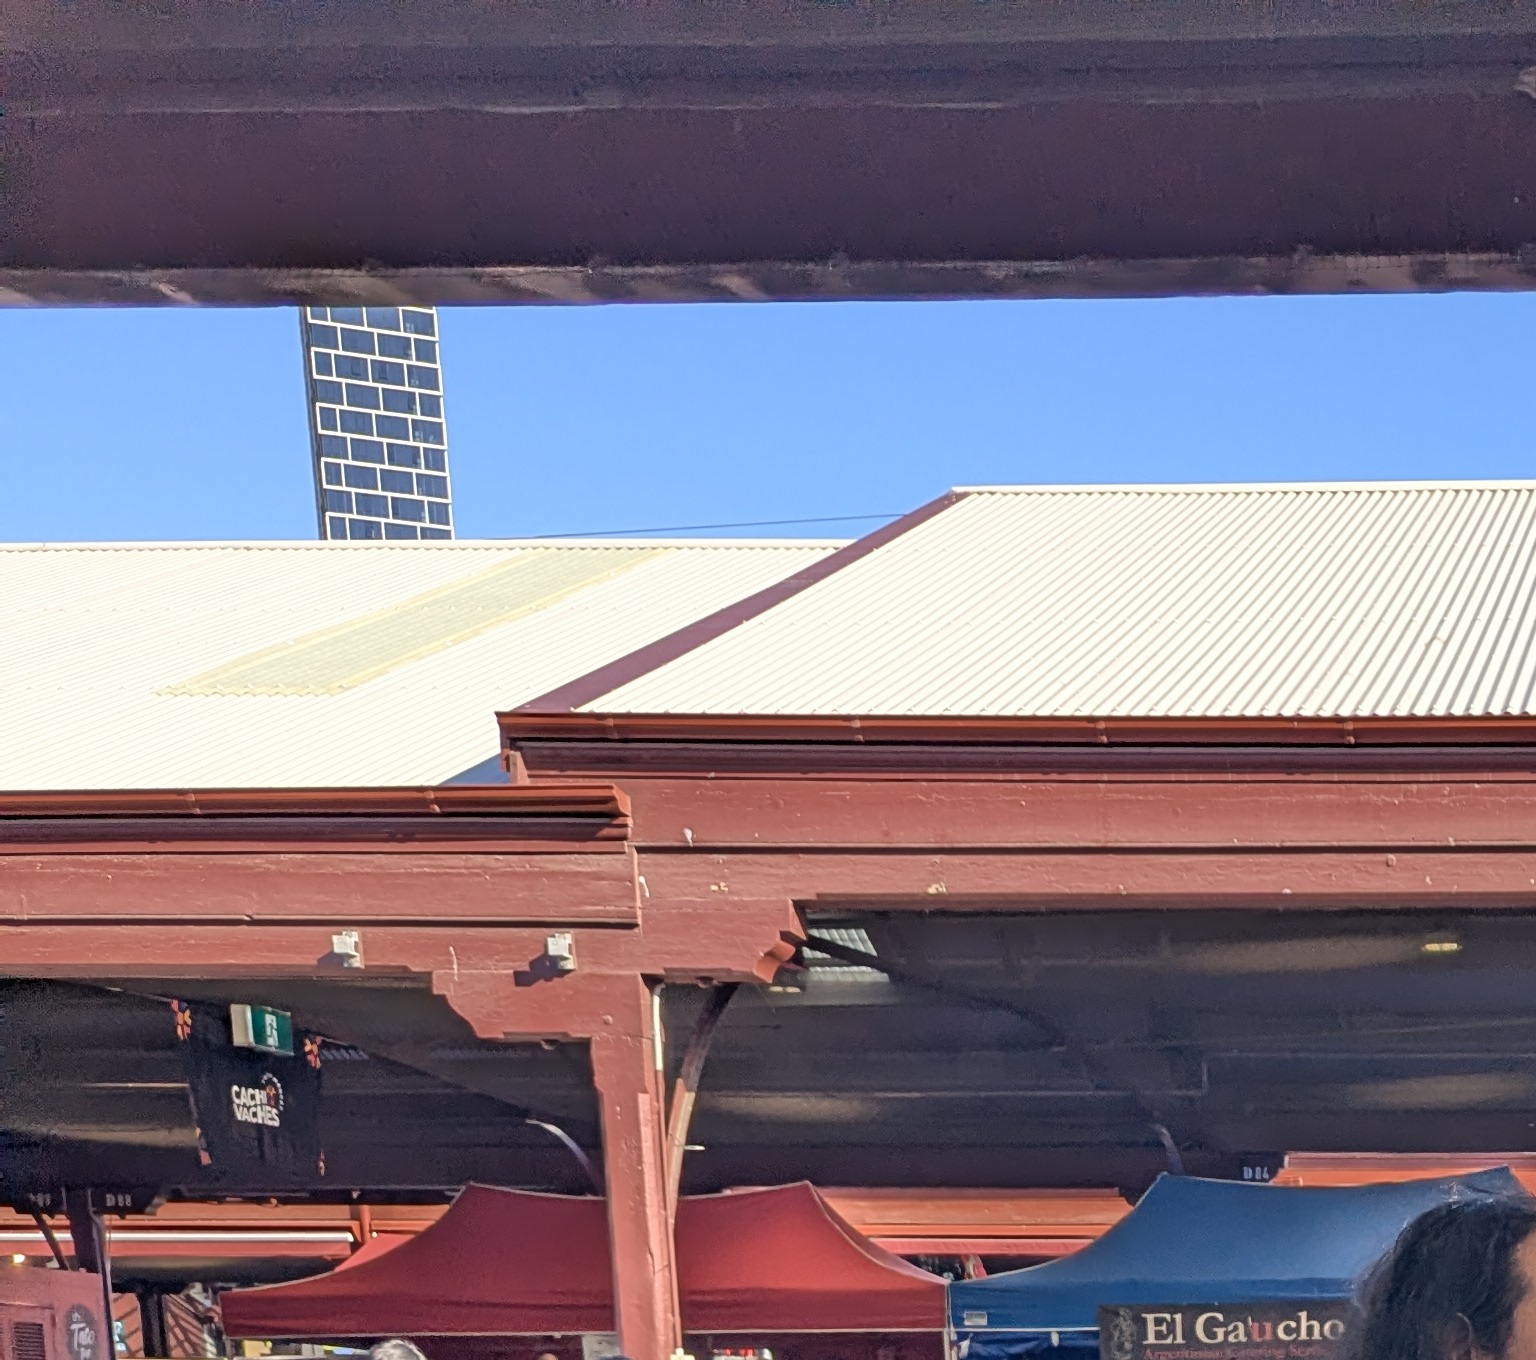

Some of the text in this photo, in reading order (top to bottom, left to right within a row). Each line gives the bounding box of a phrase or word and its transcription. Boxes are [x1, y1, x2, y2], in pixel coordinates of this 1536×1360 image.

[231, 1084, 268, 1106] CACHI
[233, 1103, 280, 1127] VACHES
[1141, 1311, 1346, 1345] El Gaucho
